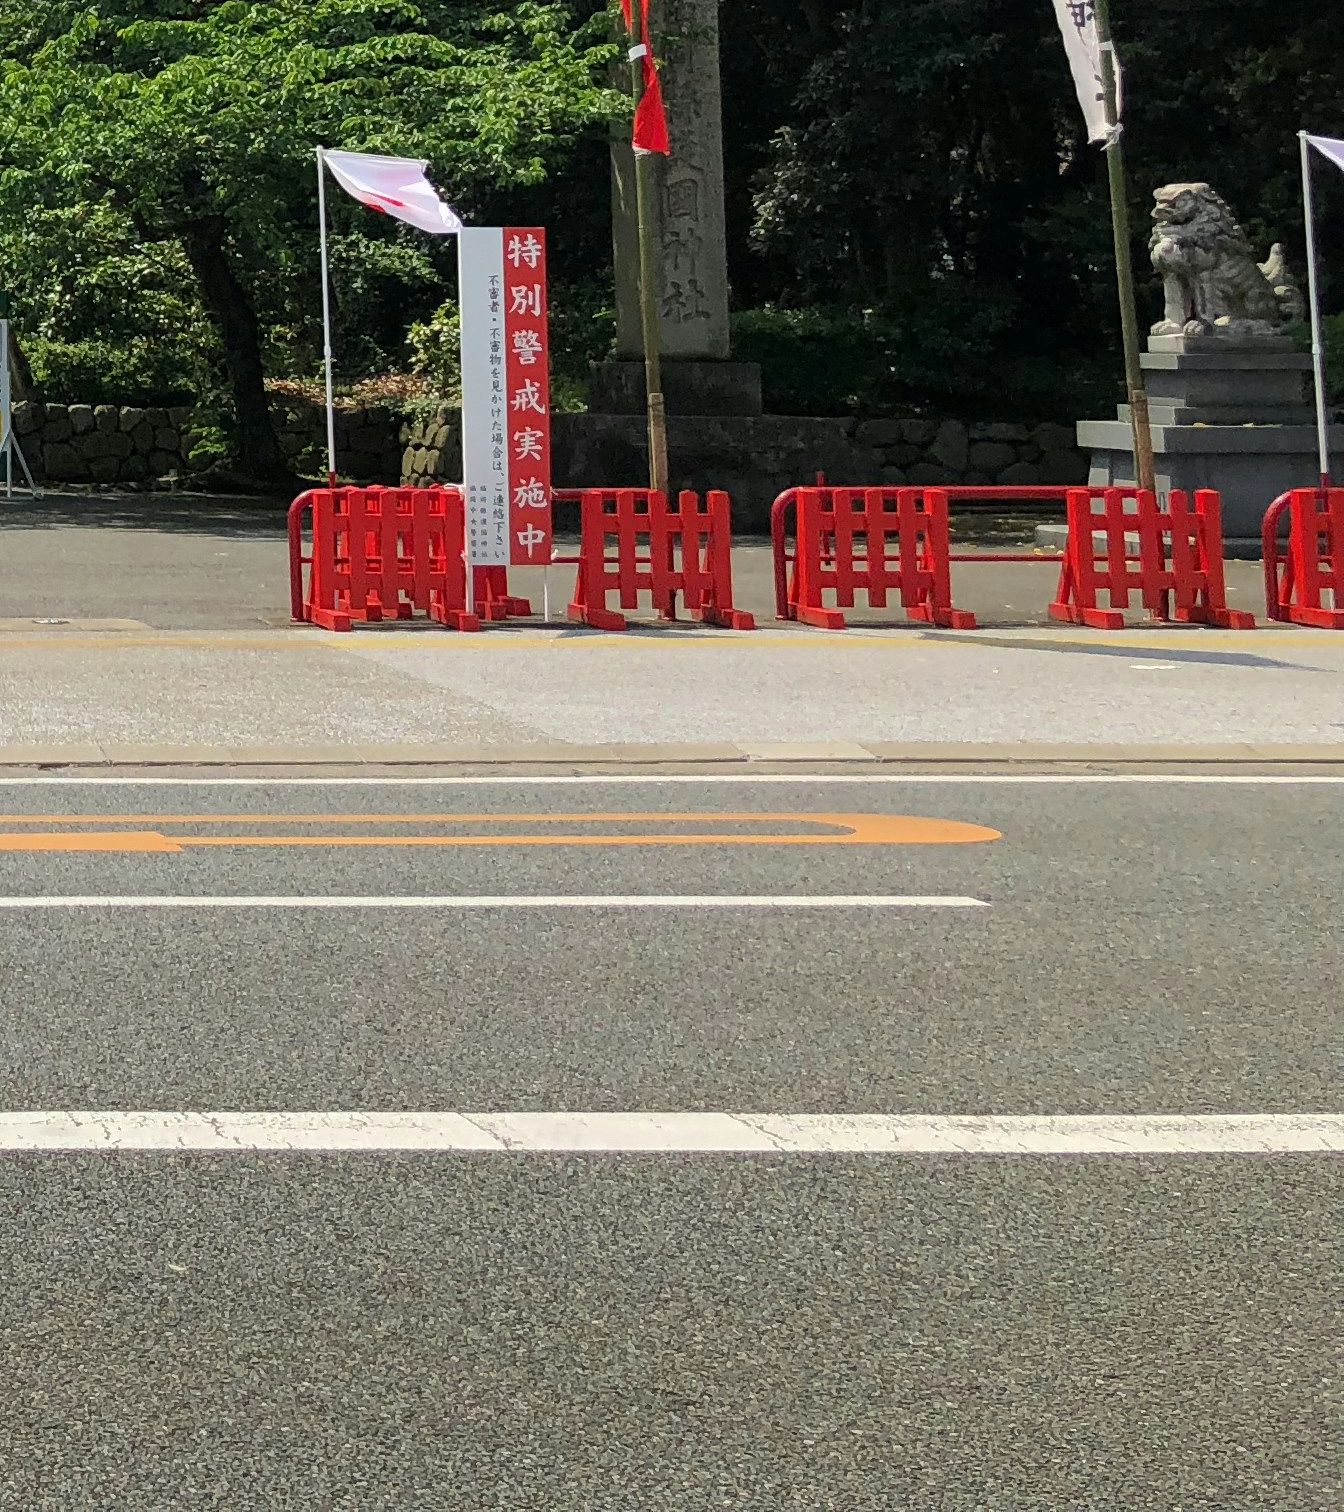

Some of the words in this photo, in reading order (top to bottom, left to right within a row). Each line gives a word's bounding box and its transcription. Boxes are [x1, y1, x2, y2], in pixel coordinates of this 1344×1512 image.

[507, 233, 548, 559] 特別警戒実施中
